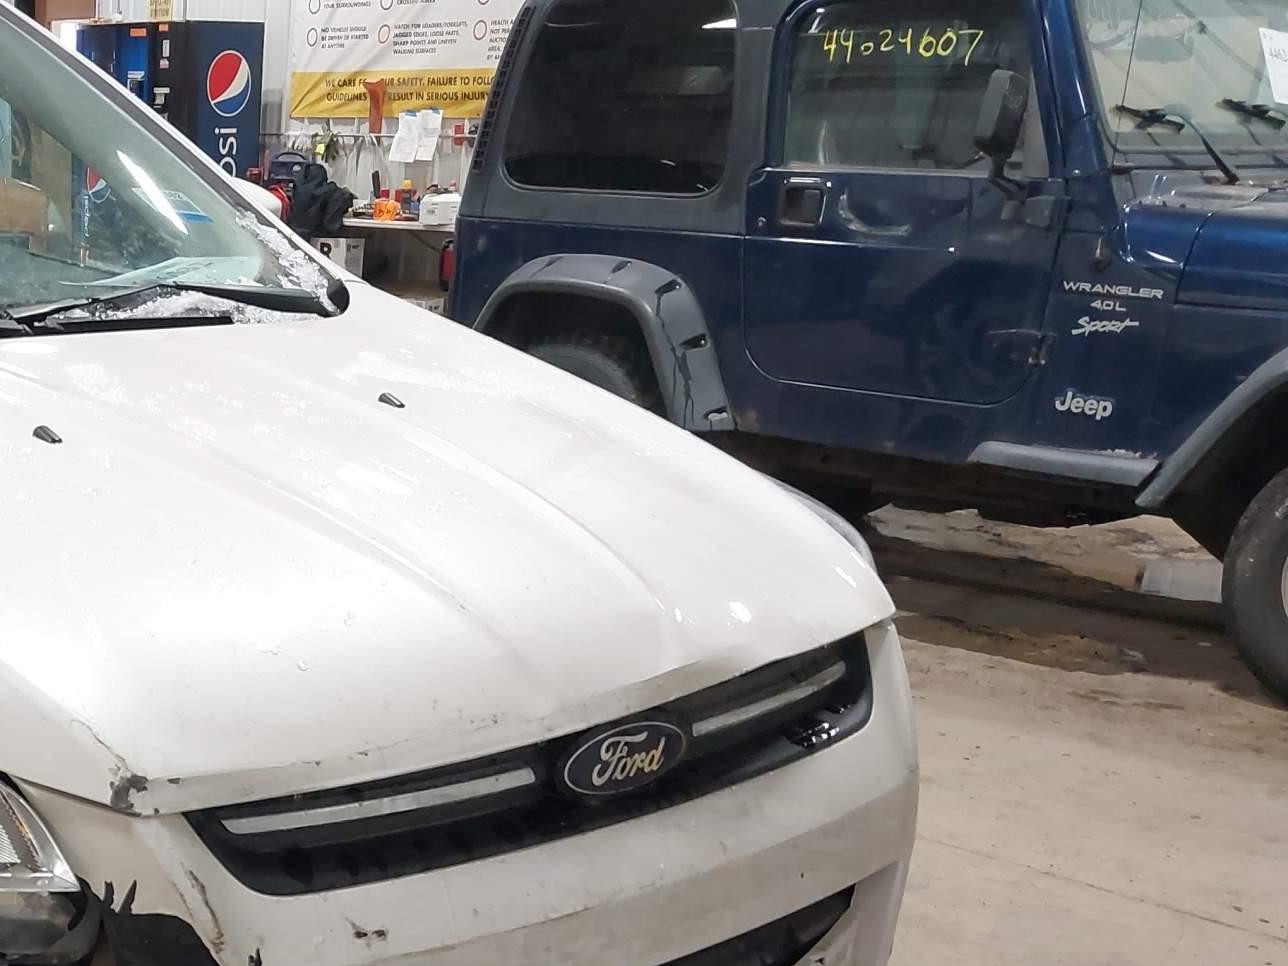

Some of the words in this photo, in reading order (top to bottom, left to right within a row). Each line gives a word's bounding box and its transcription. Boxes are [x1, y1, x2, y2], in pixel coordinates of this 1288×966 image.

[337, 78, 357, 88] CARE
[427, 76, 458, 86] FAILURE
[460, 76, 470, 86] TO
[326, 92, 368, 102] GUIDELINES
[415, 91, 424, 101] IN
[425, 90, 459, 101] SERIOUS
[1062, 280, 1165, 300] WRANGLER
[1071, 316, 1140, 337] Sport
[1054, 391, 1114, 421] Jeep
[591, 731, 667, 787] Ford
